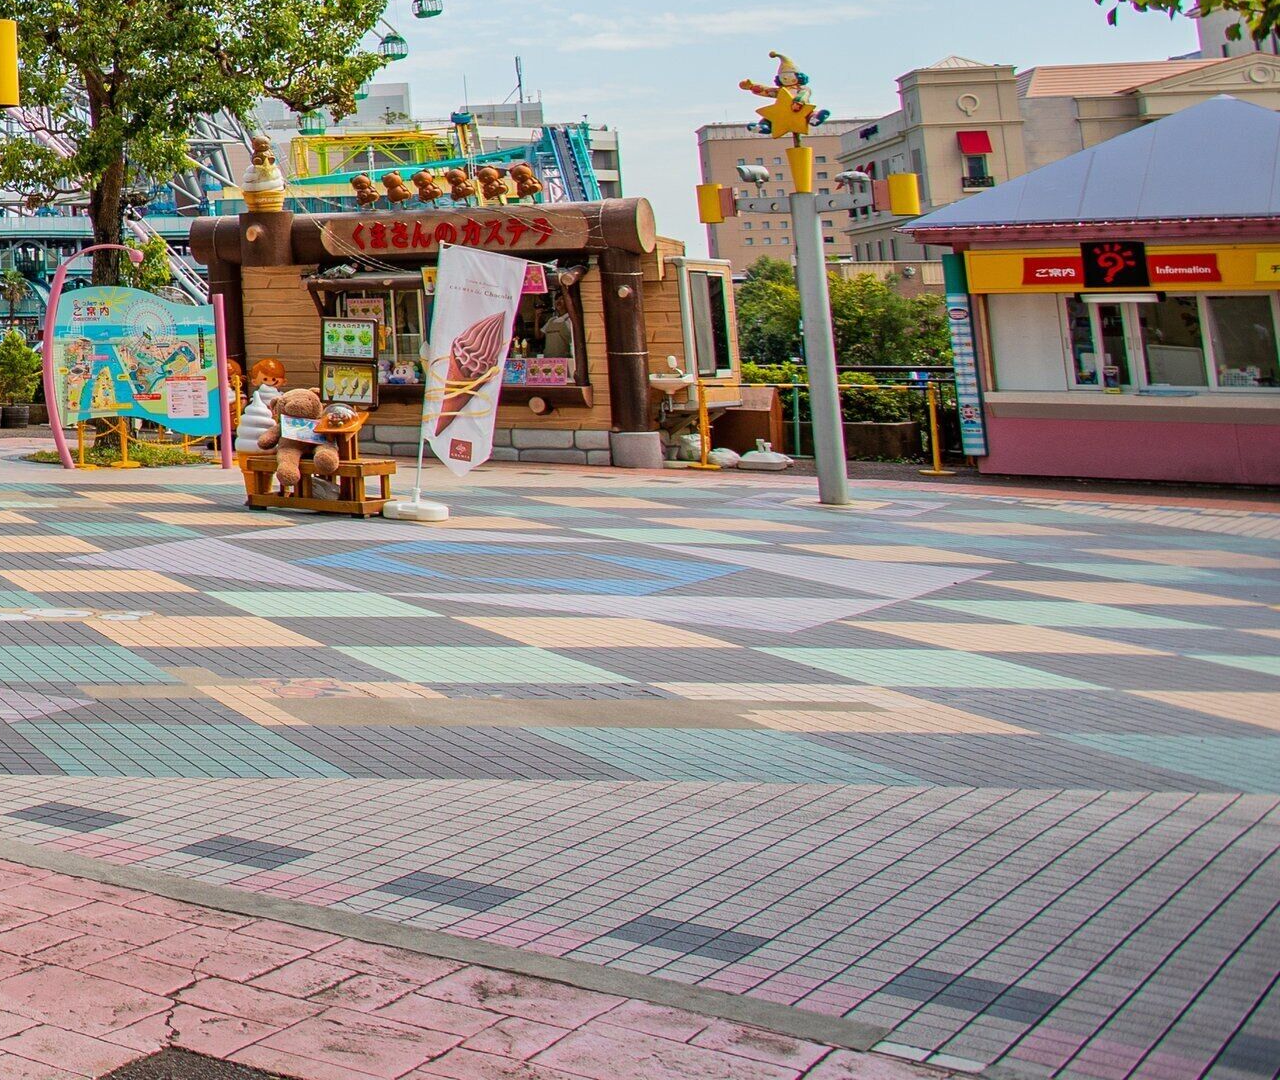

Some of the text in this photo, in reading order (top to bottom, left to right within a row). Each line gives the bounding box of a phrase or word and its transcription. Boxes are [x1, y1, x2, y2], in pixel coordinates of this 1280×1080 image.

[352, 218, 553, 250] くまさんのカステラ
[1156, 265, 1211, 275] Information
